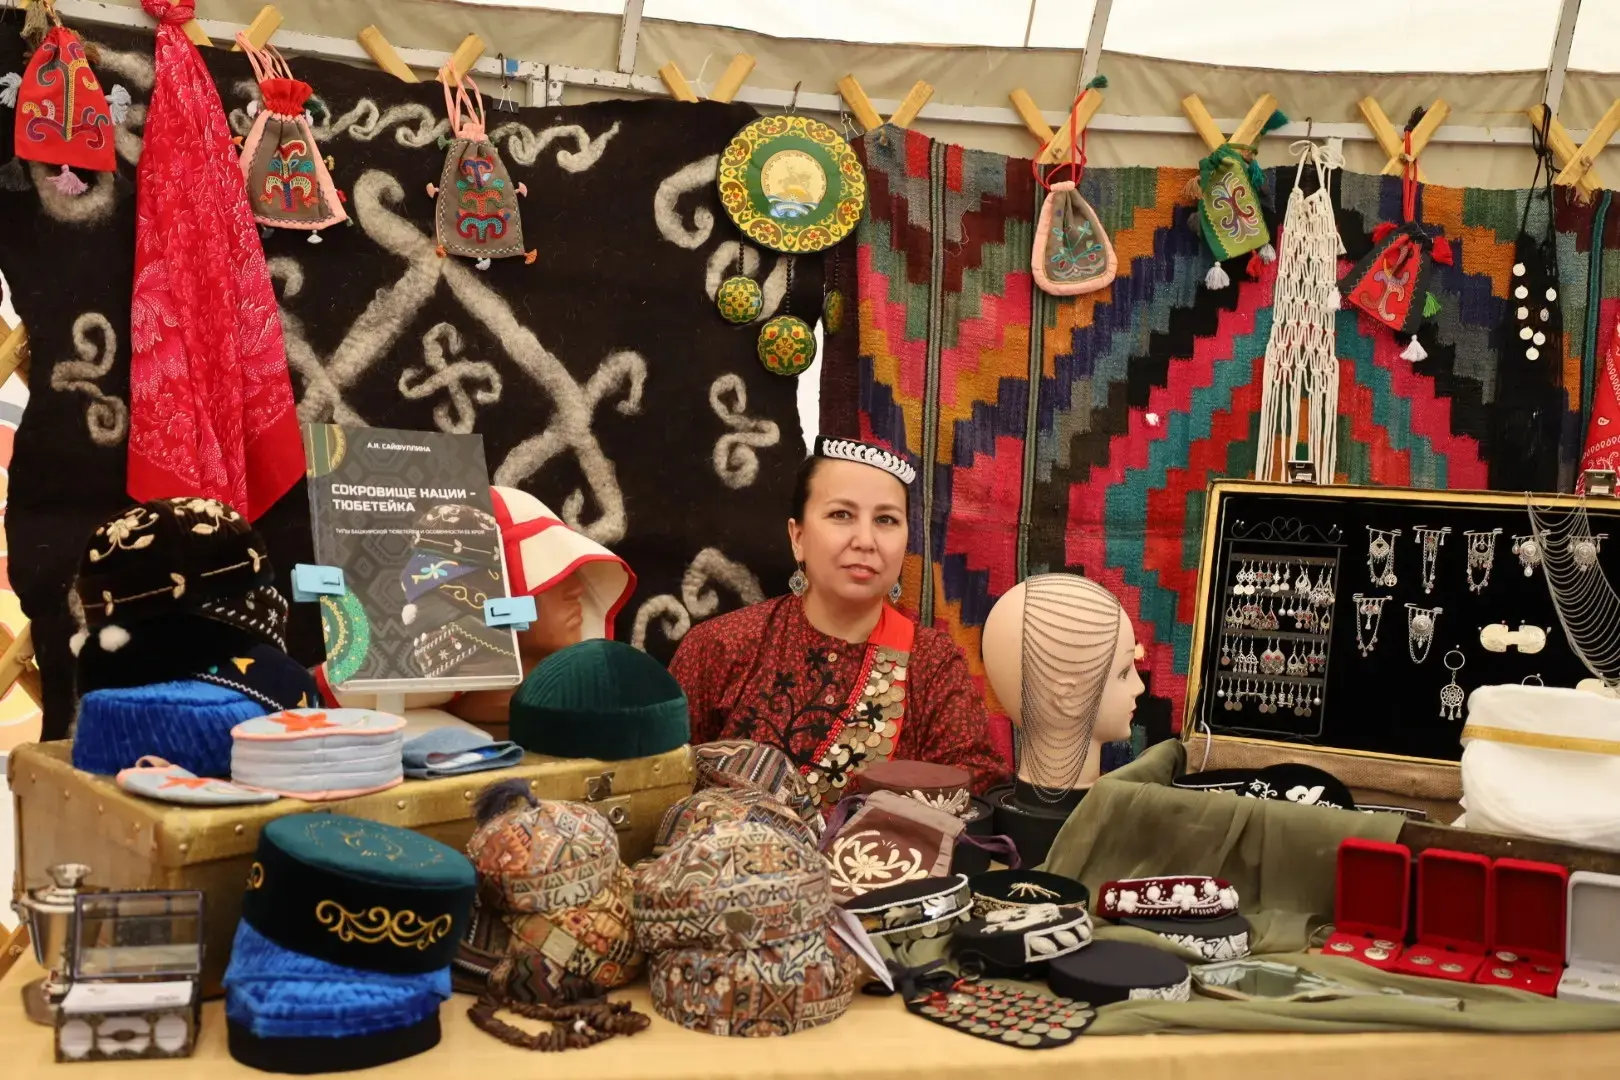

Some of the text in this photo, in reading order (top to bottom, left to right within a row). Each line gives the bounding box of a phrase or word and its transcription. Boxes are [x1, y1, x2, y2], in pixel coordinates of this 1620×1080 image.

[382, 443, 431, 452] САЙФУЛЛИНА
[331, 483, 417, 499] СОКРОВИЩЕ
[420, 487, 467, 500] НАЦИИ
[332, 498, 416, 512] ТЮБЕТЕЙКА
